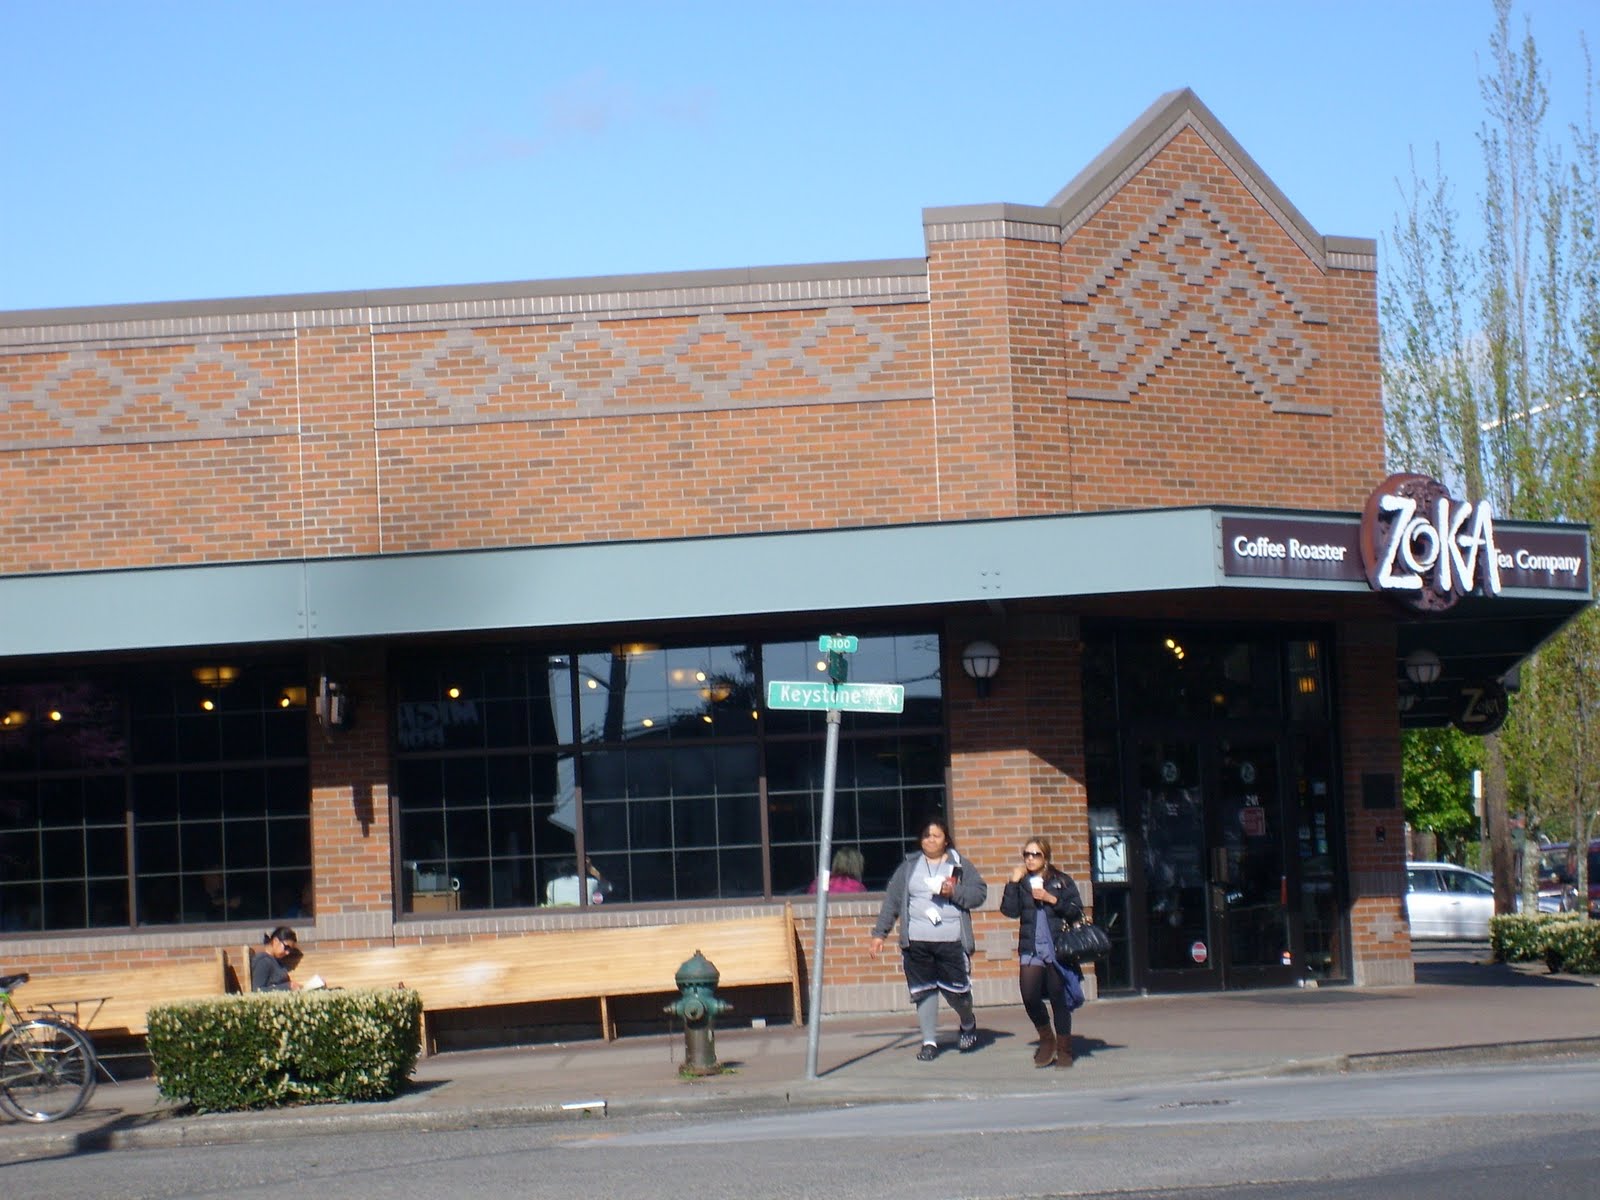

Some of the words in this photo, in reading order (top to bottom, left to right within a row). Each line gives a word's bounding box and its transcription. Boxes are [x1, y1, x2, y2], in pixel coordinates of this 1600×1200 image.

[1233, 535, 1286, 559] Coffee
[1290, 538, 1347, 562] Roaster
[1378, 494, 1502, 595] ZOKA
[1516, 550, 1581, 577] Company
[781, 684, 860, 706] Keystone
[887, 693, 898, 705] N
